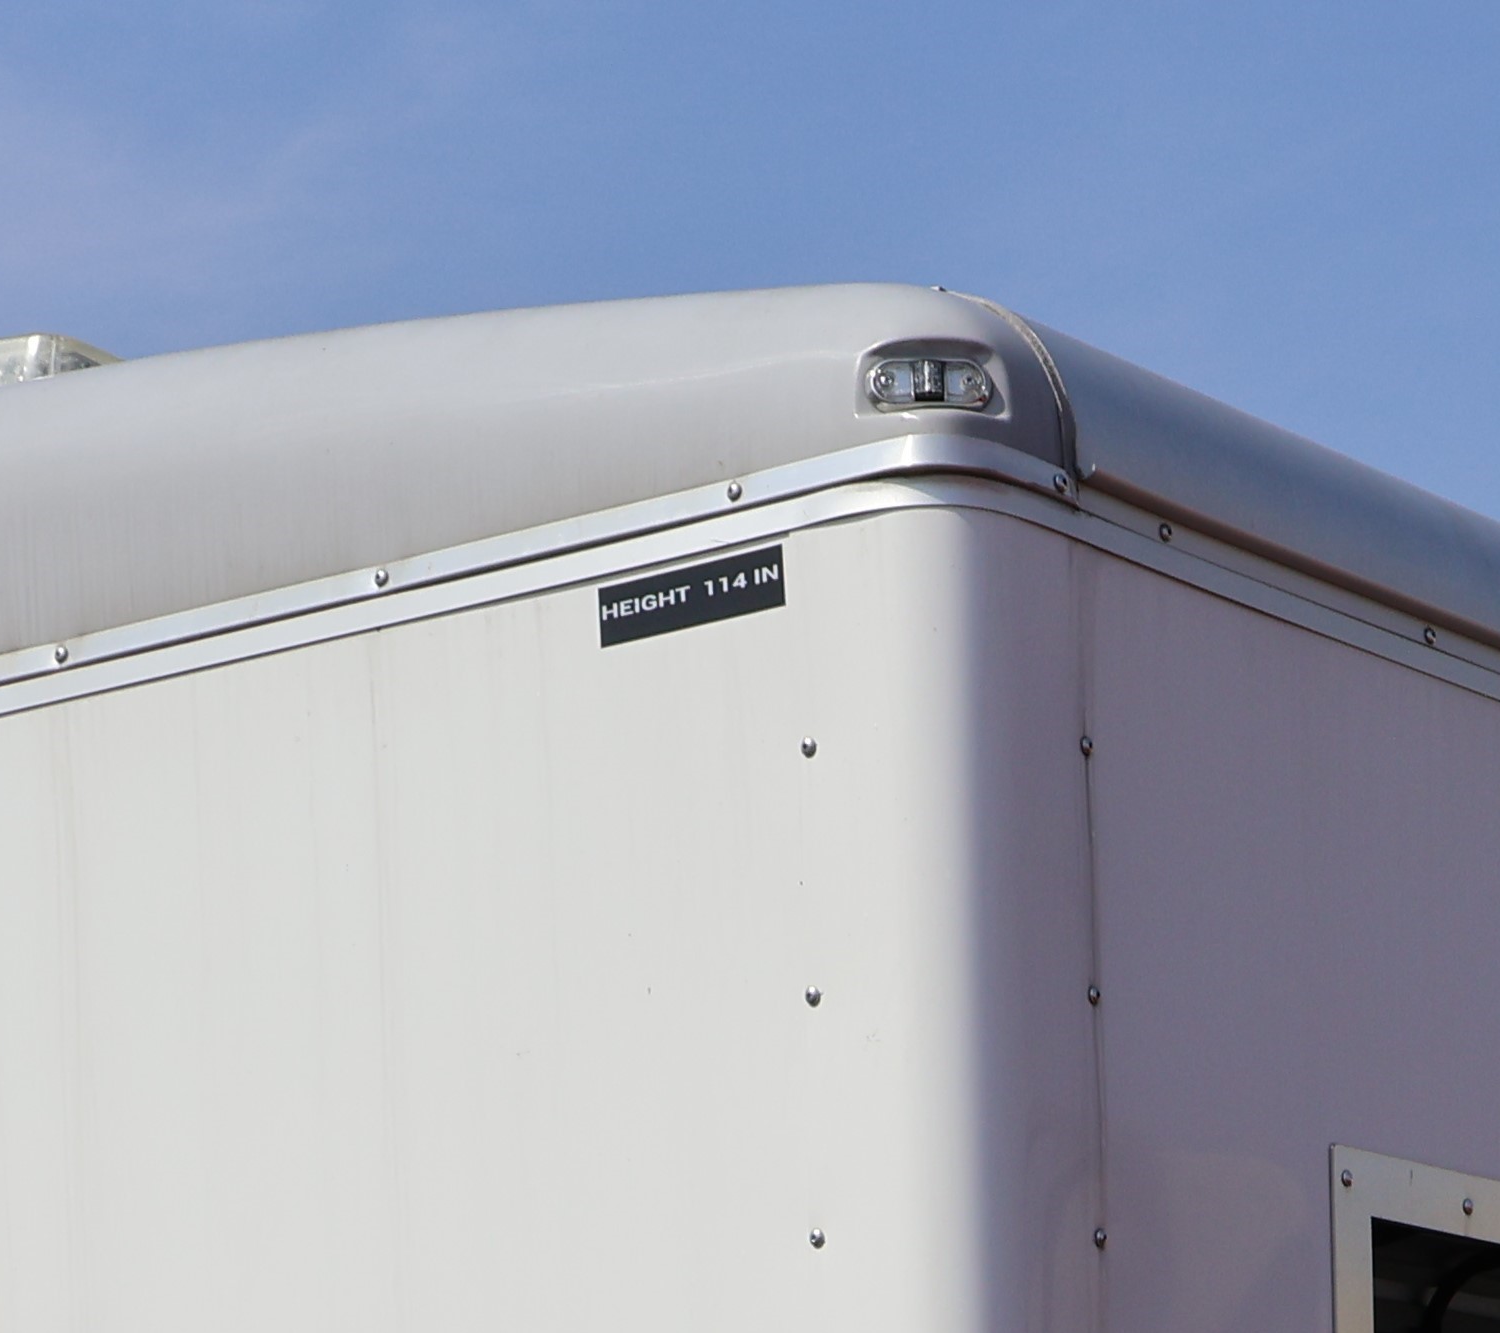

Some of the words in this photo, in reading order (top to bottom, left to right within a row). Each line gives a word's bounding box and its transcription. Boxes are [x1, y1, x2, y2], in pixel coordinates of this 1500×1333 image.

[601, 585, 691, 621] HEIGHT
[703, 572, 748, 597] 114
[754, 563, 780, 585] IN
